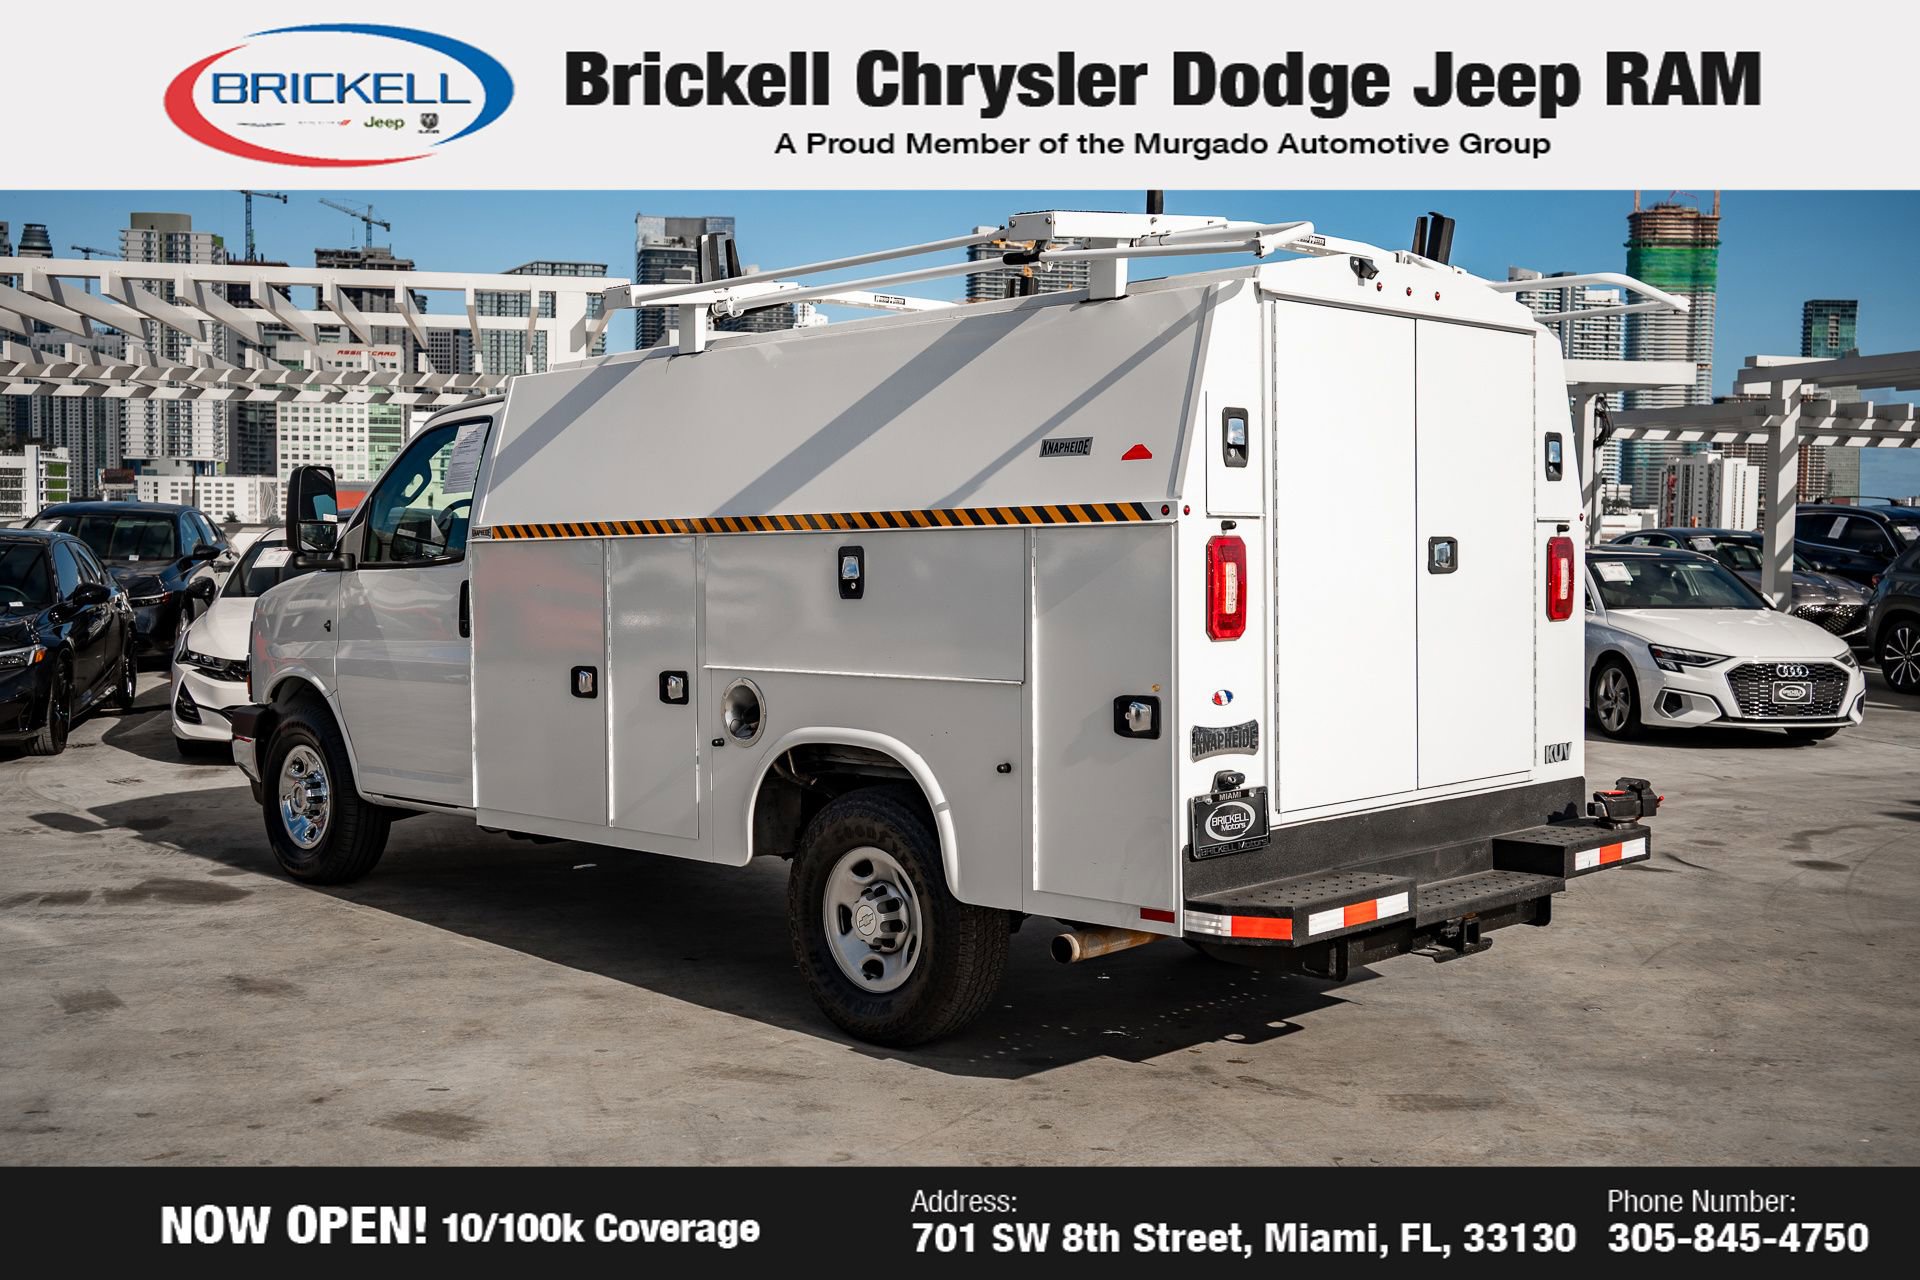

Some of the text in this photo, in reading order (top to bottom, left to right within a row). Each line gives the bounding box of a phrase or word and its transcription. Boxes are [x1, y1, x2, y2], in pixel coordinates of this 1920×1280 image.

[1042, 438, 1090, 457] KNAPHEIDE
[1194, 725, 1257, 757] KNAPHEIDE
[1544, 741, 1573, 765] KUV
[1219, 791, 1242, 801] MIAMI
[1211, 812, 1249, 827] BRICKELL
[1221, 822, 1246, 831] Motors
[1200, 843, 1237, 857] BRICKELL
